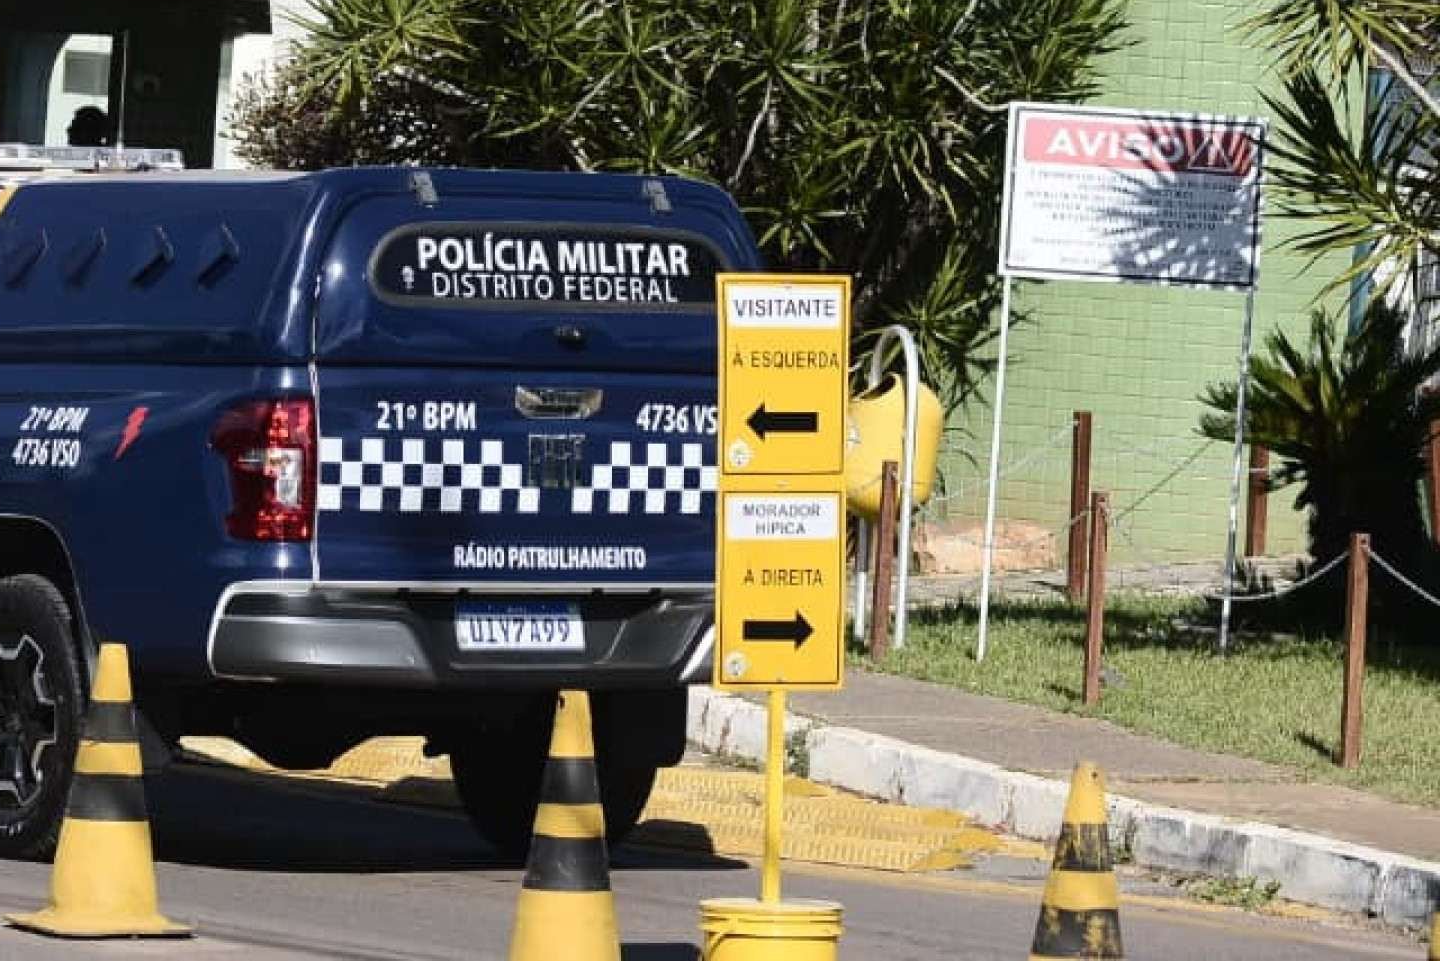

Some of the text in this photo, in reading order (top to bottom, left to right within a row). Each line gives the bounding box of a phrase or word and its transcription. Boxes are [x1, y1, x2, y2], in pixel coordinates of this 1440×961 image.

[1047, 126, 1186, 164] AVISO
[417, 232, 689, 276] POLÍCIA MILITAR
[431, 271, 679, 303] DISTRITO FEDERAL
[733, 298, 837, 318] VISITANTE
[751, 350, 840, 369] ESQUERDA
[47, 407, 90, 431] BPM
[423, 402, 476, 431] BPM
[636, 403, 719, 434] 4736 VS
[12, 438, 50, 465] 4736
[743, 502, 821, 518] MORADOR
[454, 542, 647, 570] RÁDIO PATRULHAMENTO
[761, 568, 824, 586] DIREITA
